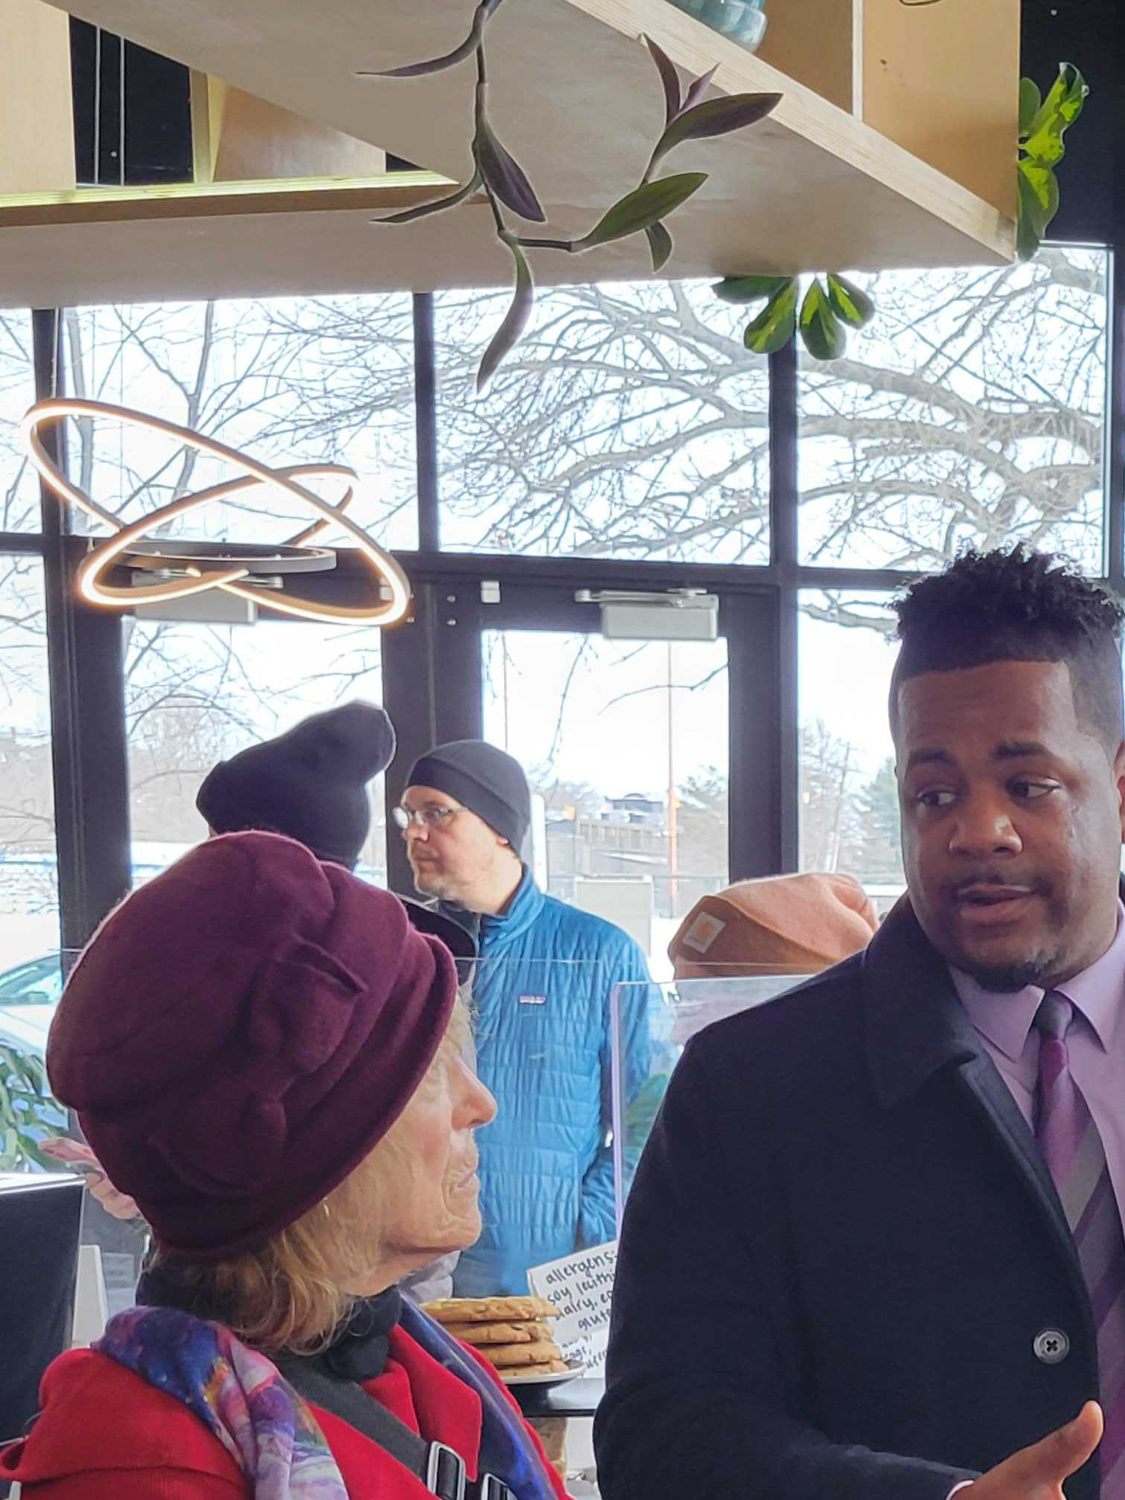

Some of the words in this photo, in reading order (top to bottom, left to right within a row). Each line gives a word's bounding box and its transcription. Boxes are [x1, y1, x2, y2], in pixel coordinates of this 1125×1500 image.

[545, 1251, 619, 1286] allergens:
[547, 1286, 573, 1307] soy
[575, 1270, 617, 1297] lecithi
[578, 1308, 612, 1332] glute
